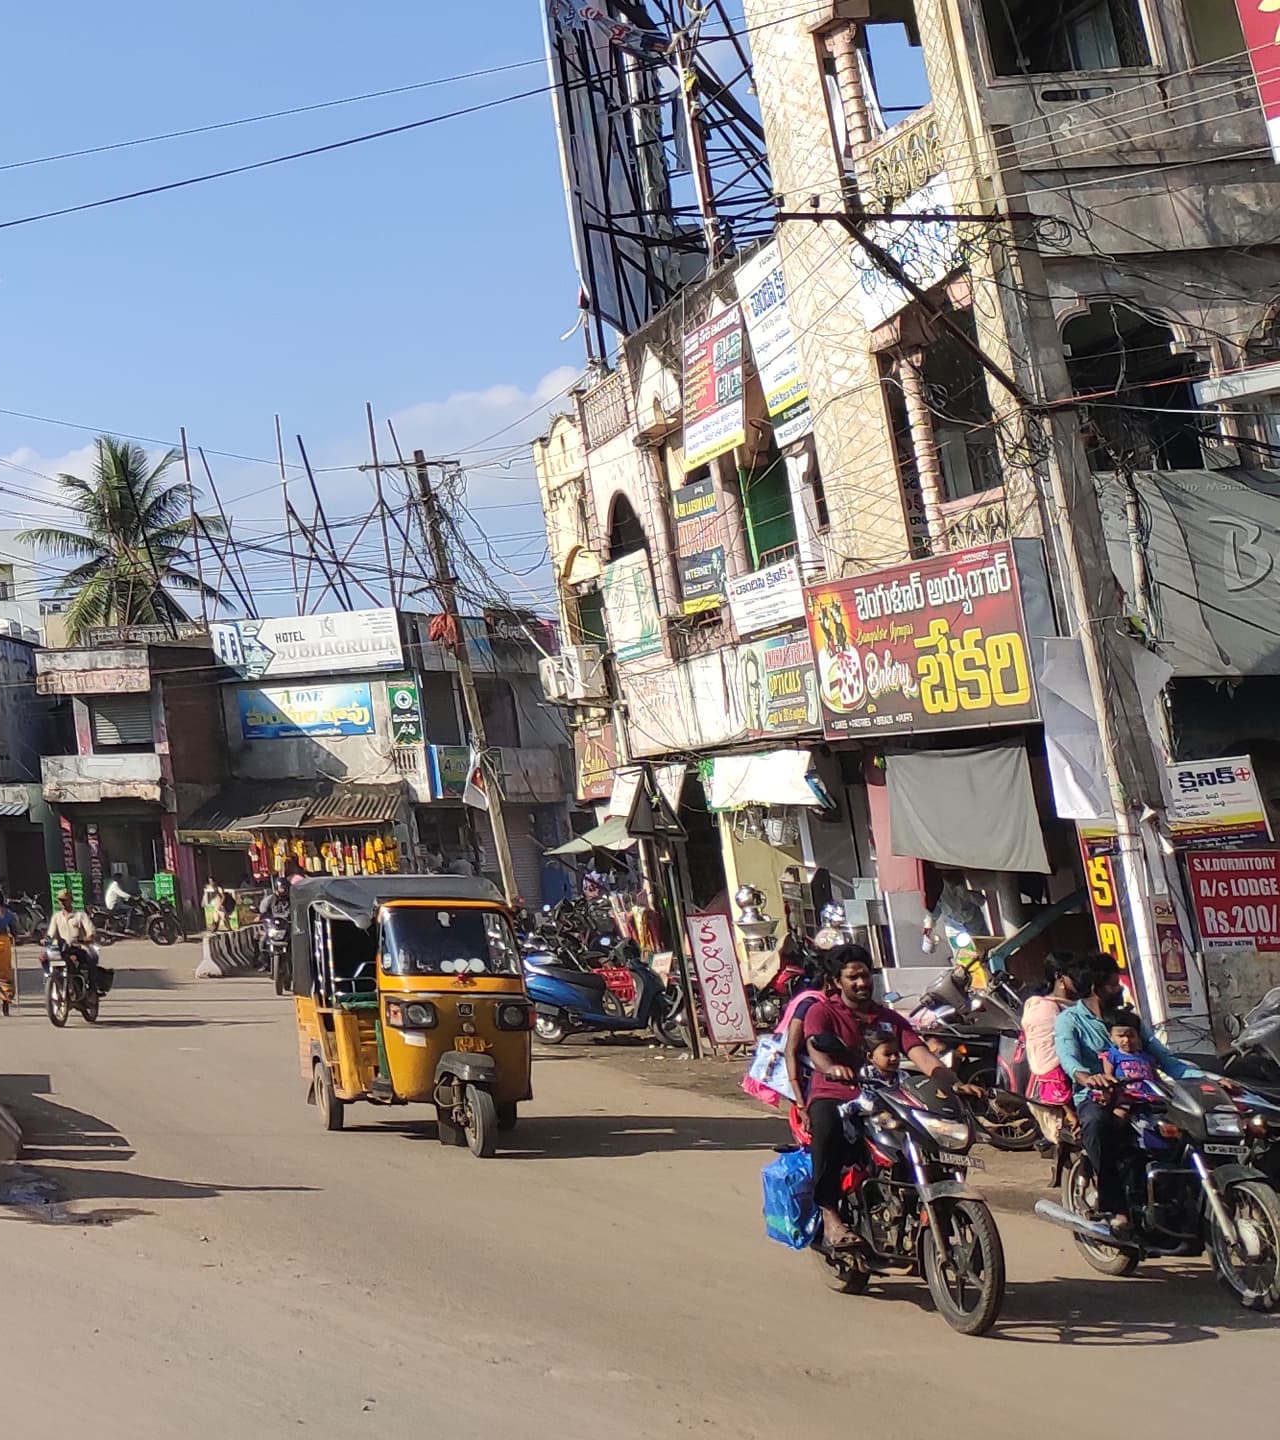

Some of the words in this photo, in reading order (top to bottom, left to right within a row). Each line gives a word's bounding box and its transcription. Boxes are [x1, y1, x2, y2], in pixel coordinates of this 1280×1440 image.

[275, 630, 306, 643] HOTEL
[914, 618, 1031, 714] బేకరి
[295, 691, 323, 704] ONE
[1193, 856, 1277, 871] S.V.DORMITORY
[1200, 879, 1228, 897] A/c
[1231, 877, 1280, 896] LODGE
